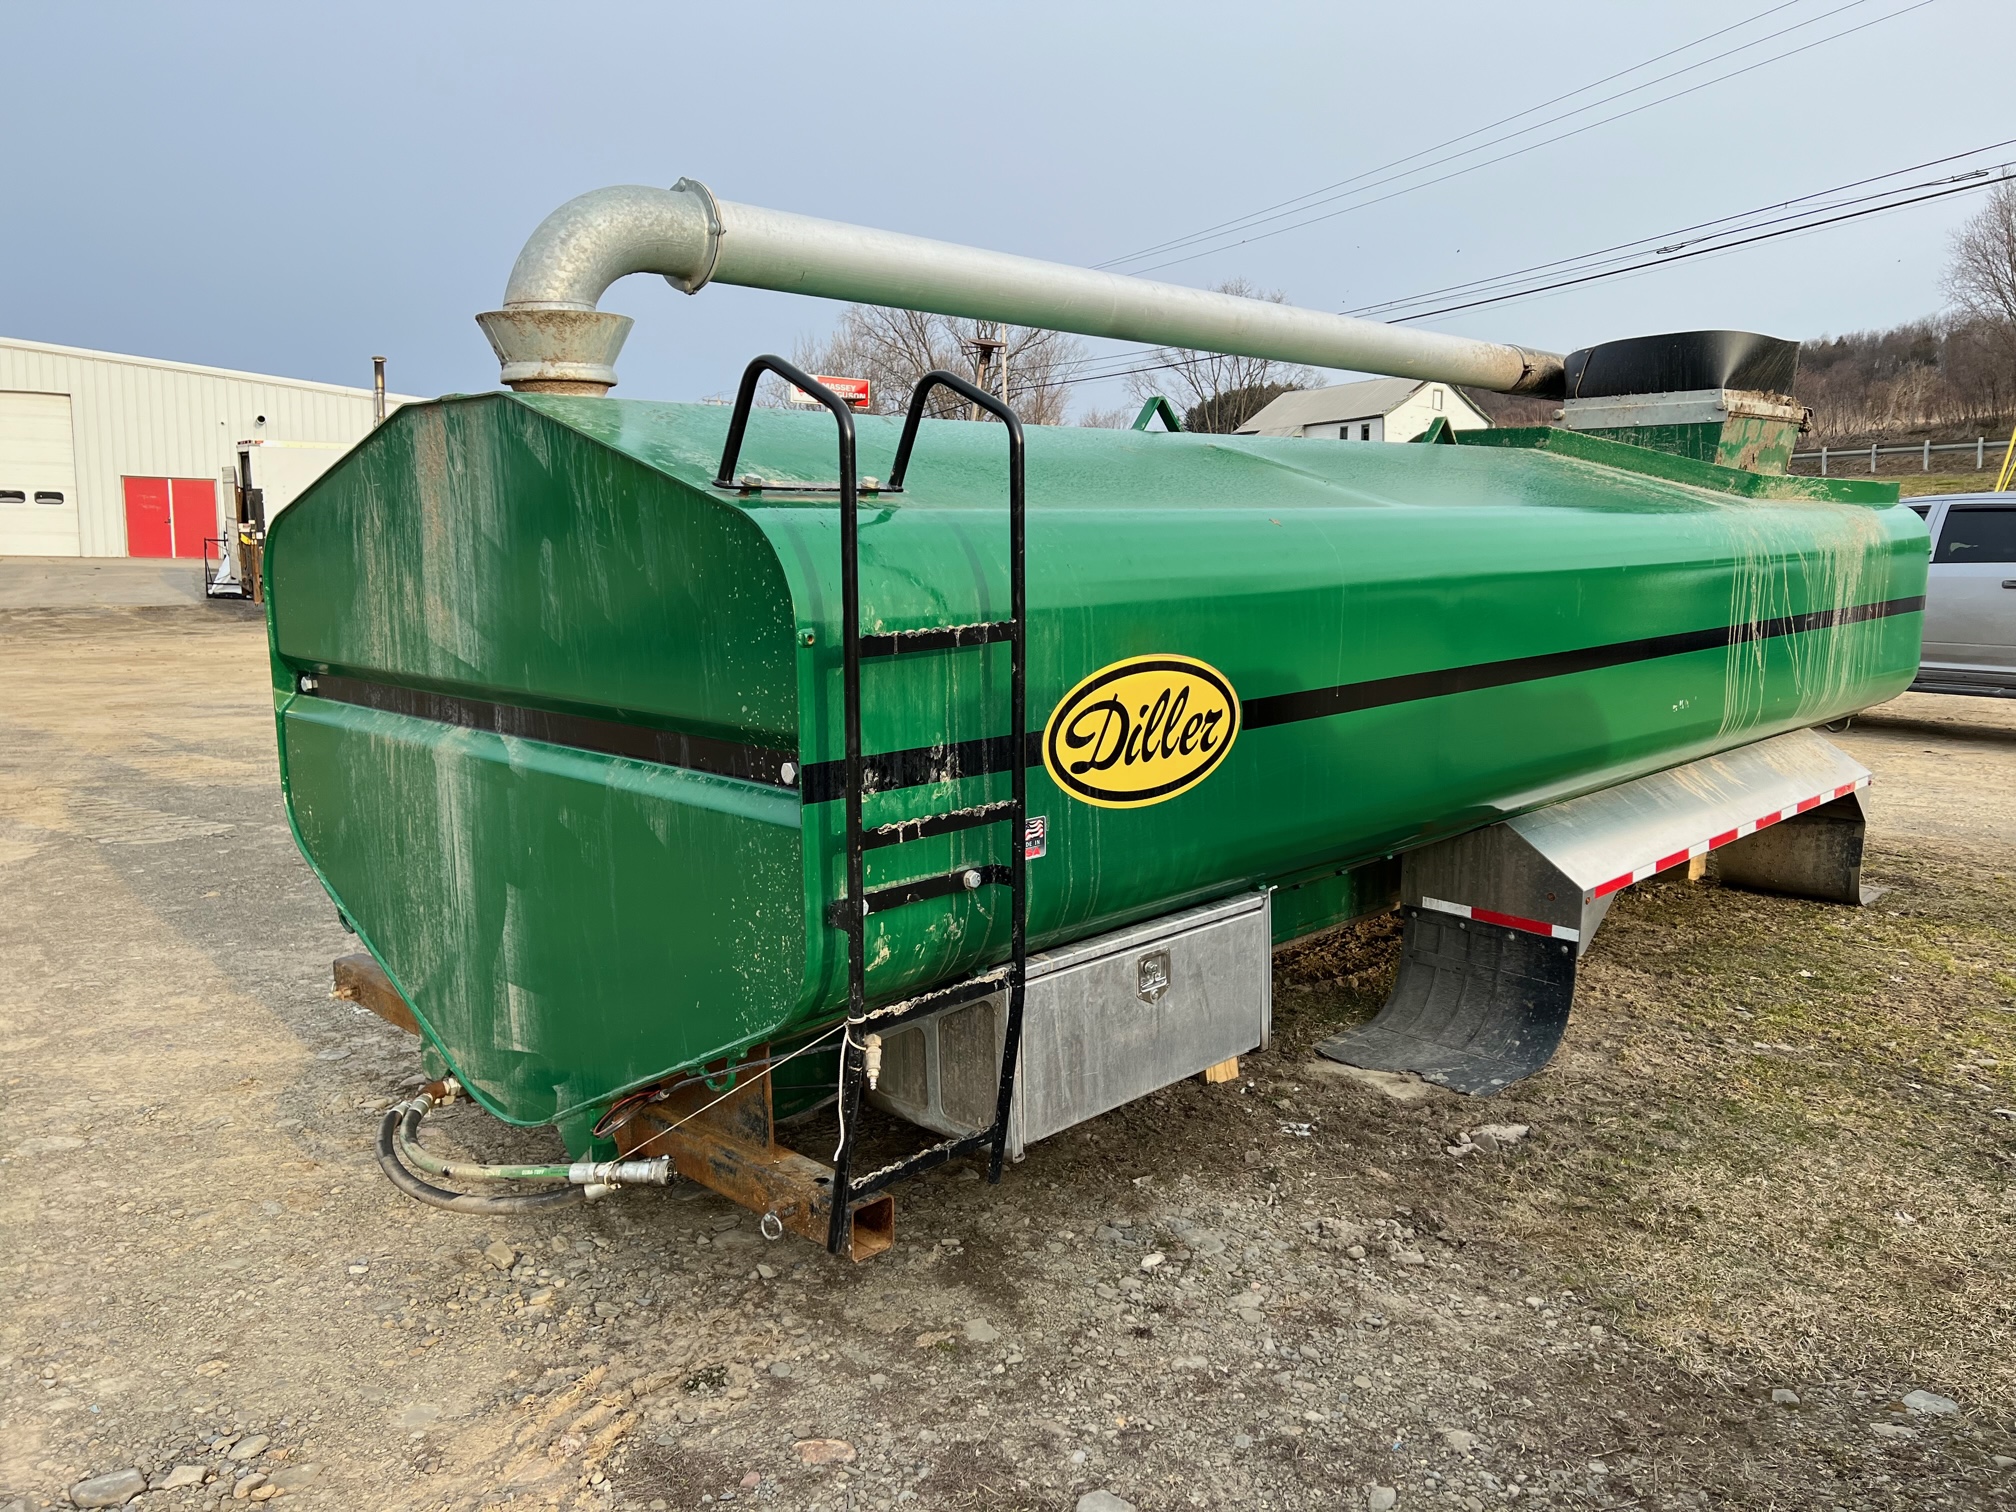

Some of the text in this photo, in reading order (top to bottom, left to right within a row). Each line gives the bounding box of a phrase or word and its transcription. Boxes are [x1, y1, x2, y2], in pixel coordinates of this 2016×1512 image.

[821, 382, 856, 392] MASSEY
[836, 391, 866, 399] GUSON
[1065, 685, 1223, 775] Diller
[1025, 846, 1041, 858] SA
